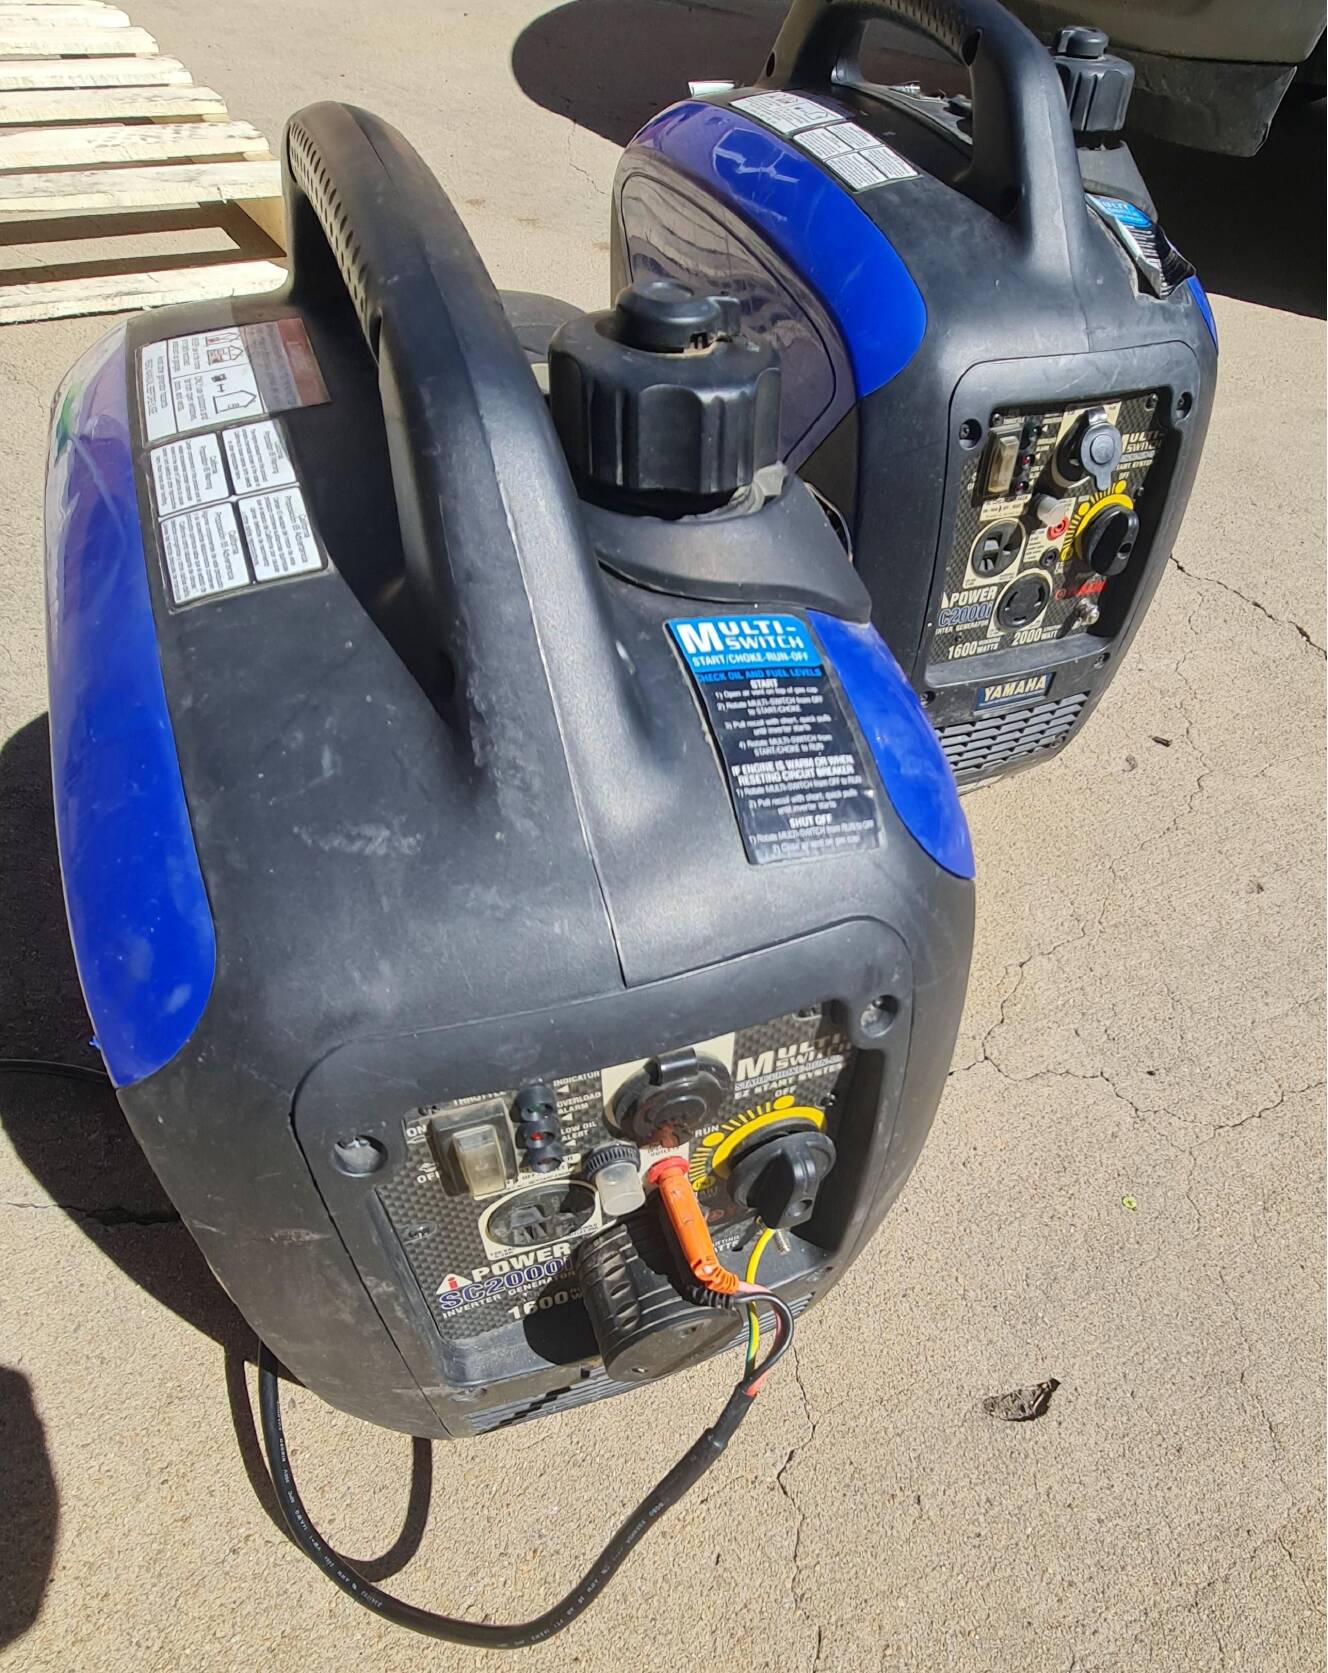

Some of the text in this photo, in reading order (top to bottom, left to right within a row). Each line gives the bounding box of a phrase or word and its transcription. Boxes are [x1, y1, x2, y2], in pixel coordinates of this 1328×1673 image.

[950, 586, 998, 608] POWER
[676, 620, 796, 654] MULTI-
[725, 635, 804, 650] SWITCH
[1012, 628, 1042, 646] 2000
[949, 641, 977, 659] 1600
[692, 652, 809, 667] START/CHOKE-RUN-OFF
[697, 668, 822, 683] CHECK OIL AND FUEL LEVELS
[750, 678, 778, 689] START
[985, 675, 1046, 701] YAMAHA
[742, 761, 775, 775] ENGINE
[785, 758, 814, 769] WARM
[827, 755, 855, 765] WHEN
[782, 769, 815, 781] CIRCUIT
[816, 765, 855, 777] BREAKER
[789, 813, 832, 829] SHUT OFF
[553, 1070, 601, 1086] INDICATOR
[754, 1078, 794, 1094] START
[556, 1092, 601, 1108] OVERLOAD
[775, 1086, 797, 1098] OFF
[557, 1102, 589, 1115] ALARM
[406, 1124, 427, 1137] ON
[560, 1125, 582, 1135] LOW
[561, 1131, 589, 1142] ALERT
[695, 1125, 719, 1138] RUN
[471, 1243, 572, 1283] POWER
[442, 1294, 502, 1319] INVERTER
[508, 1270, 576, 1296] GENERATOR
[508, 1290, 568, 1320] 1600
